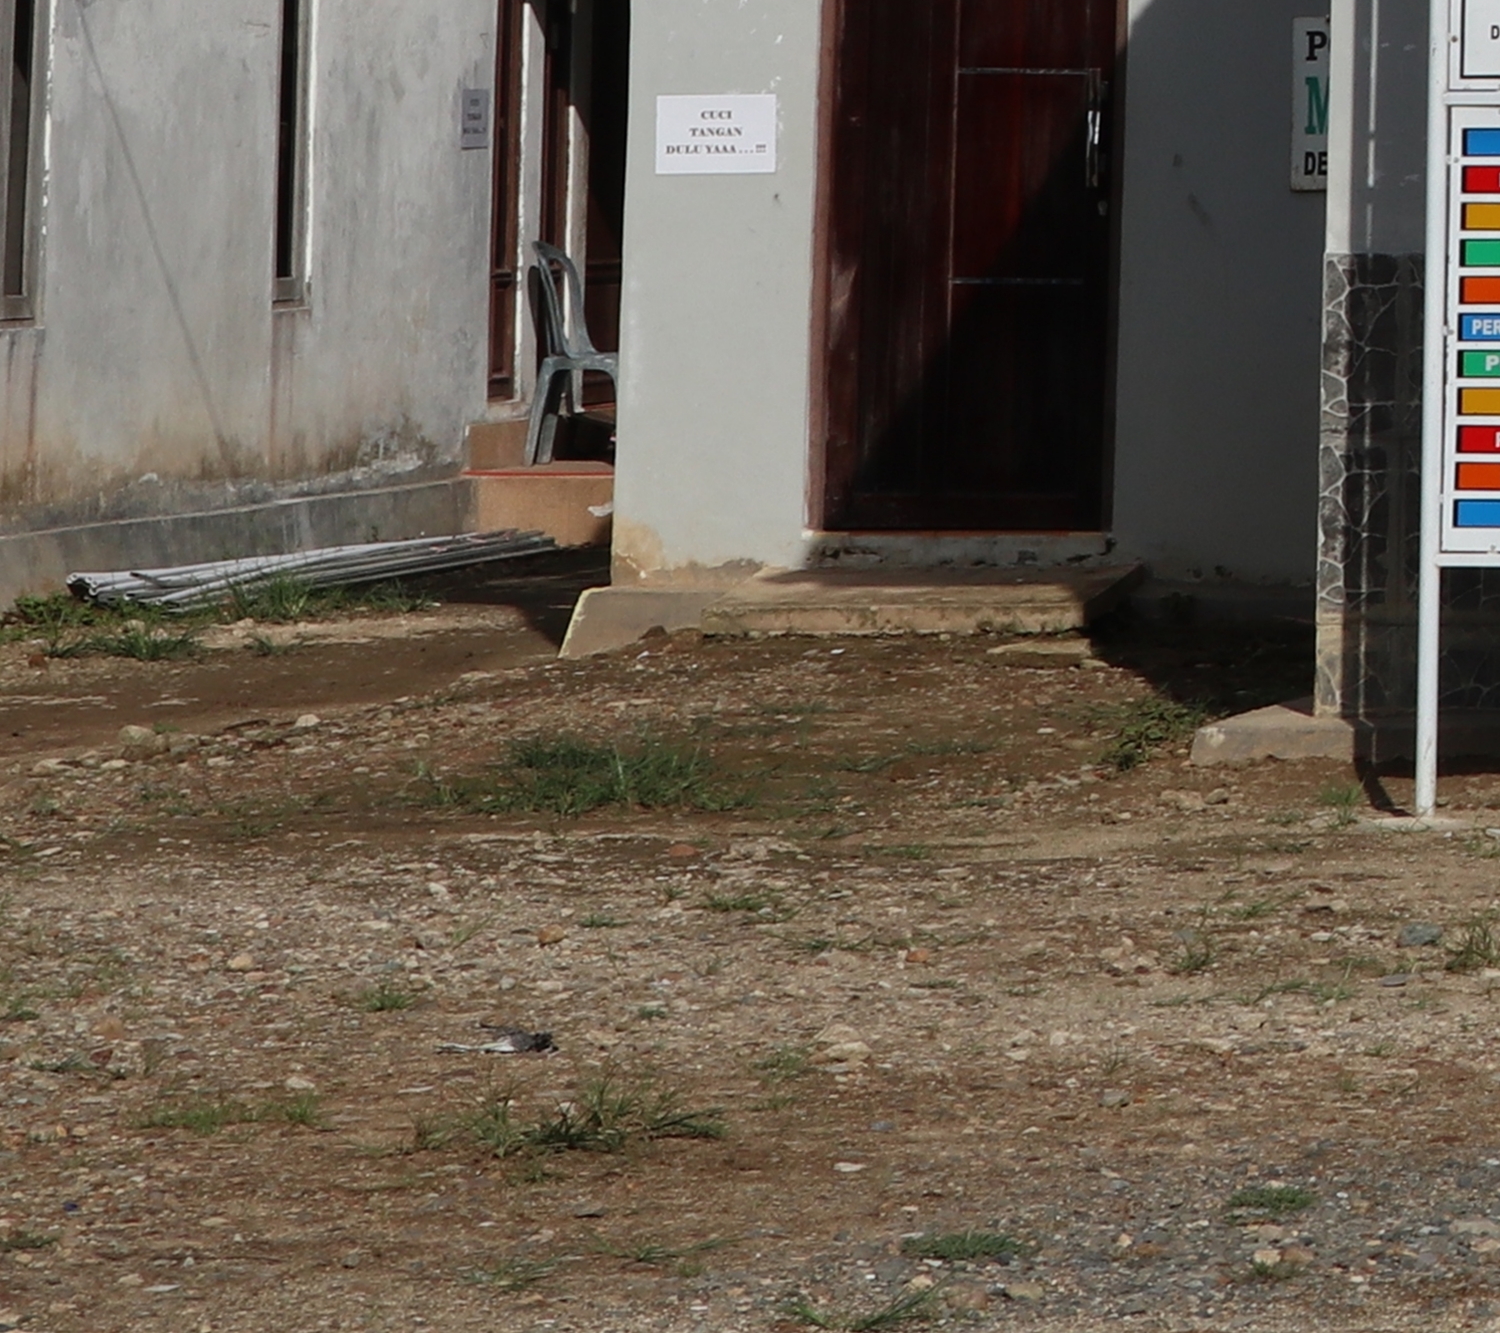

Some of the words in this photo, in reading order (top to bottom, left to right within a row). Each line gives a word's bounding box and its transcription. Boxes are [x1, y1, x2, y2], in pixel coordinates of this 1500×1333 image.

[700, 110, 732, 120] CUCI
[689, 127, 743, 137] TANGAN
[665, 144, 703, 155] DULU
